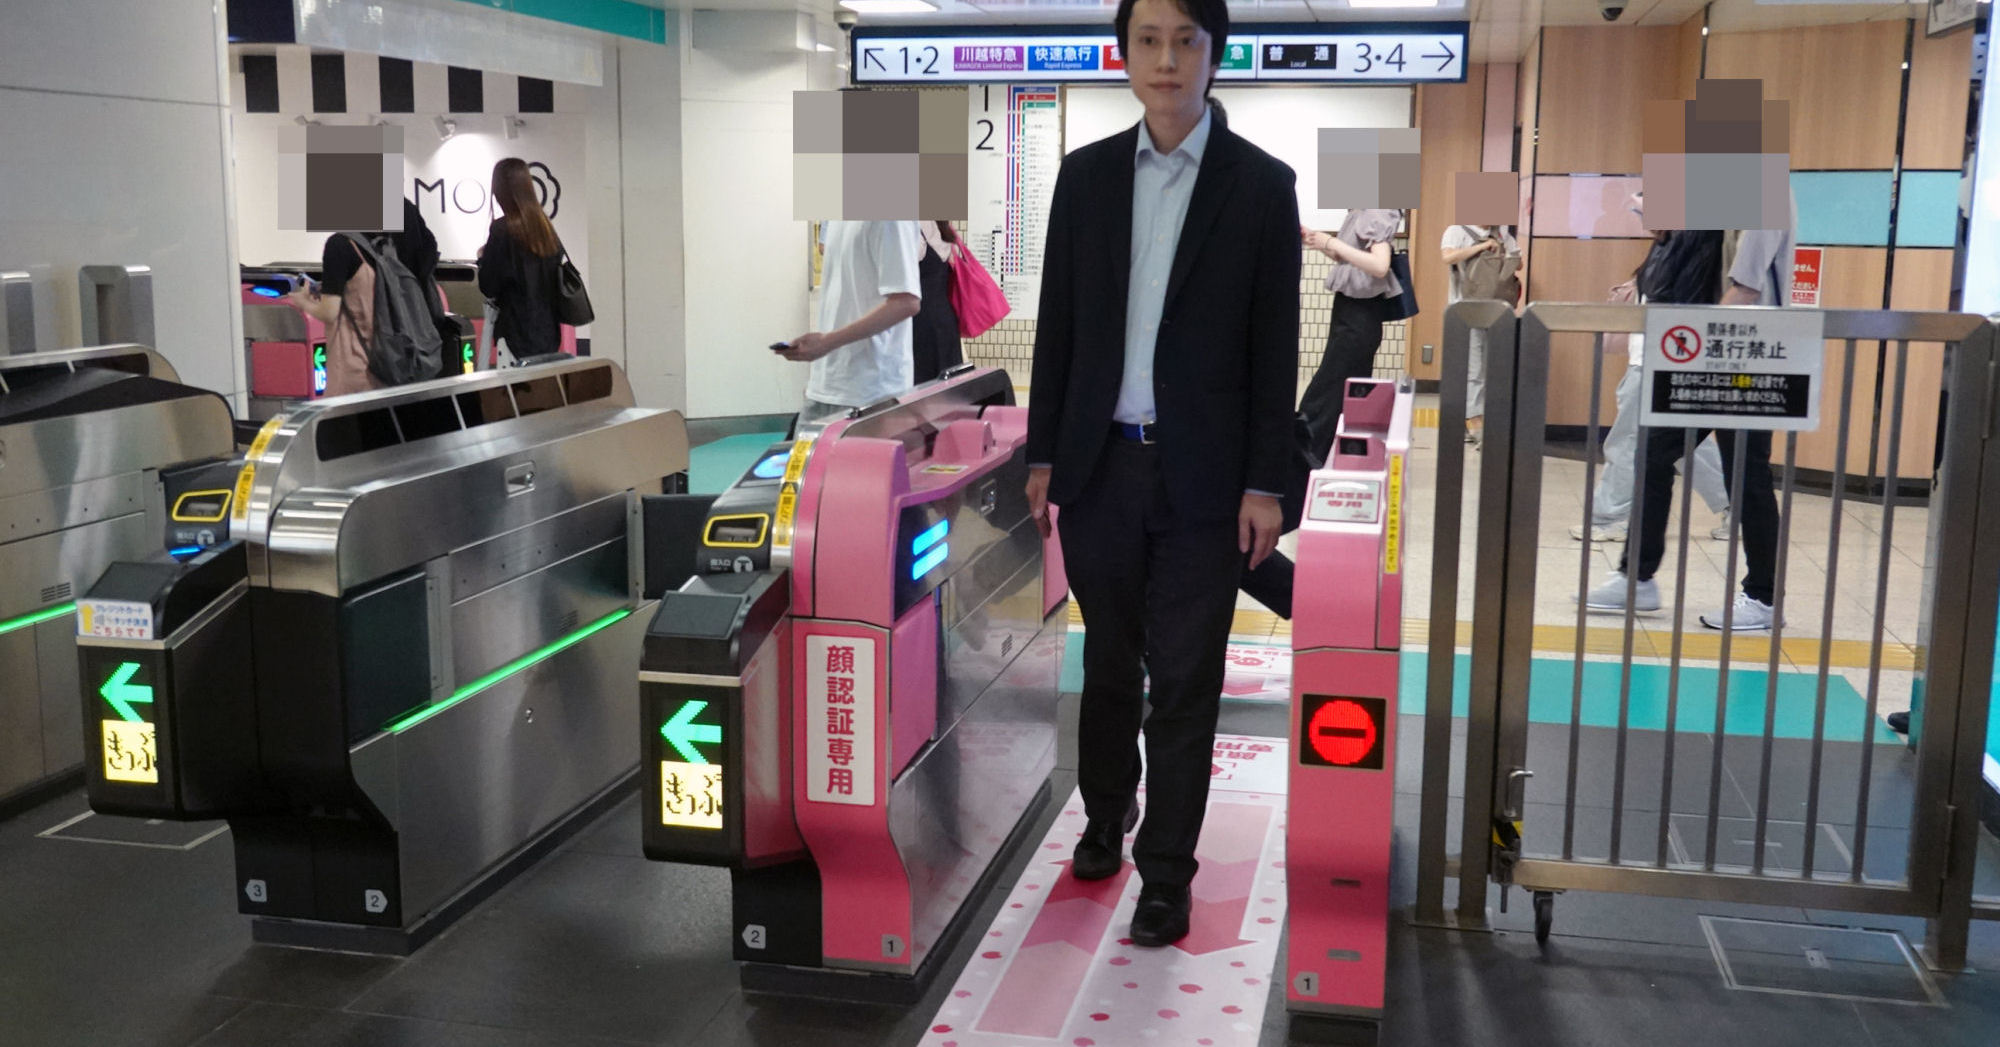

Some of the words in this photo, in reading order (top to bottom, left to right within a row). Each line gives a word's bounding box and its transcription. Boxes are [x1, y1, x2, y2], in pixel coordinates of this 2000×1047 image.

[961, 47, 1017, 61] 川越特急
[1035, 46, 1092, 61] 快速急行
[976, 119, 994, 150] 2
[1707, 322, 1758, 337] 関係者以外
[1705, 339, 1787, 360] 通行禁止
[94, 626, 145, 637] こちらです
[827, 645, 854, 795] 顔認証専用
[253, 884, 262, 897] 3
[371, 895, 379, 908] 2
[751, 930, 760, 943] 2
[887, 940, 894, 953] 1
[1303, 977, 1311, 991] 1
